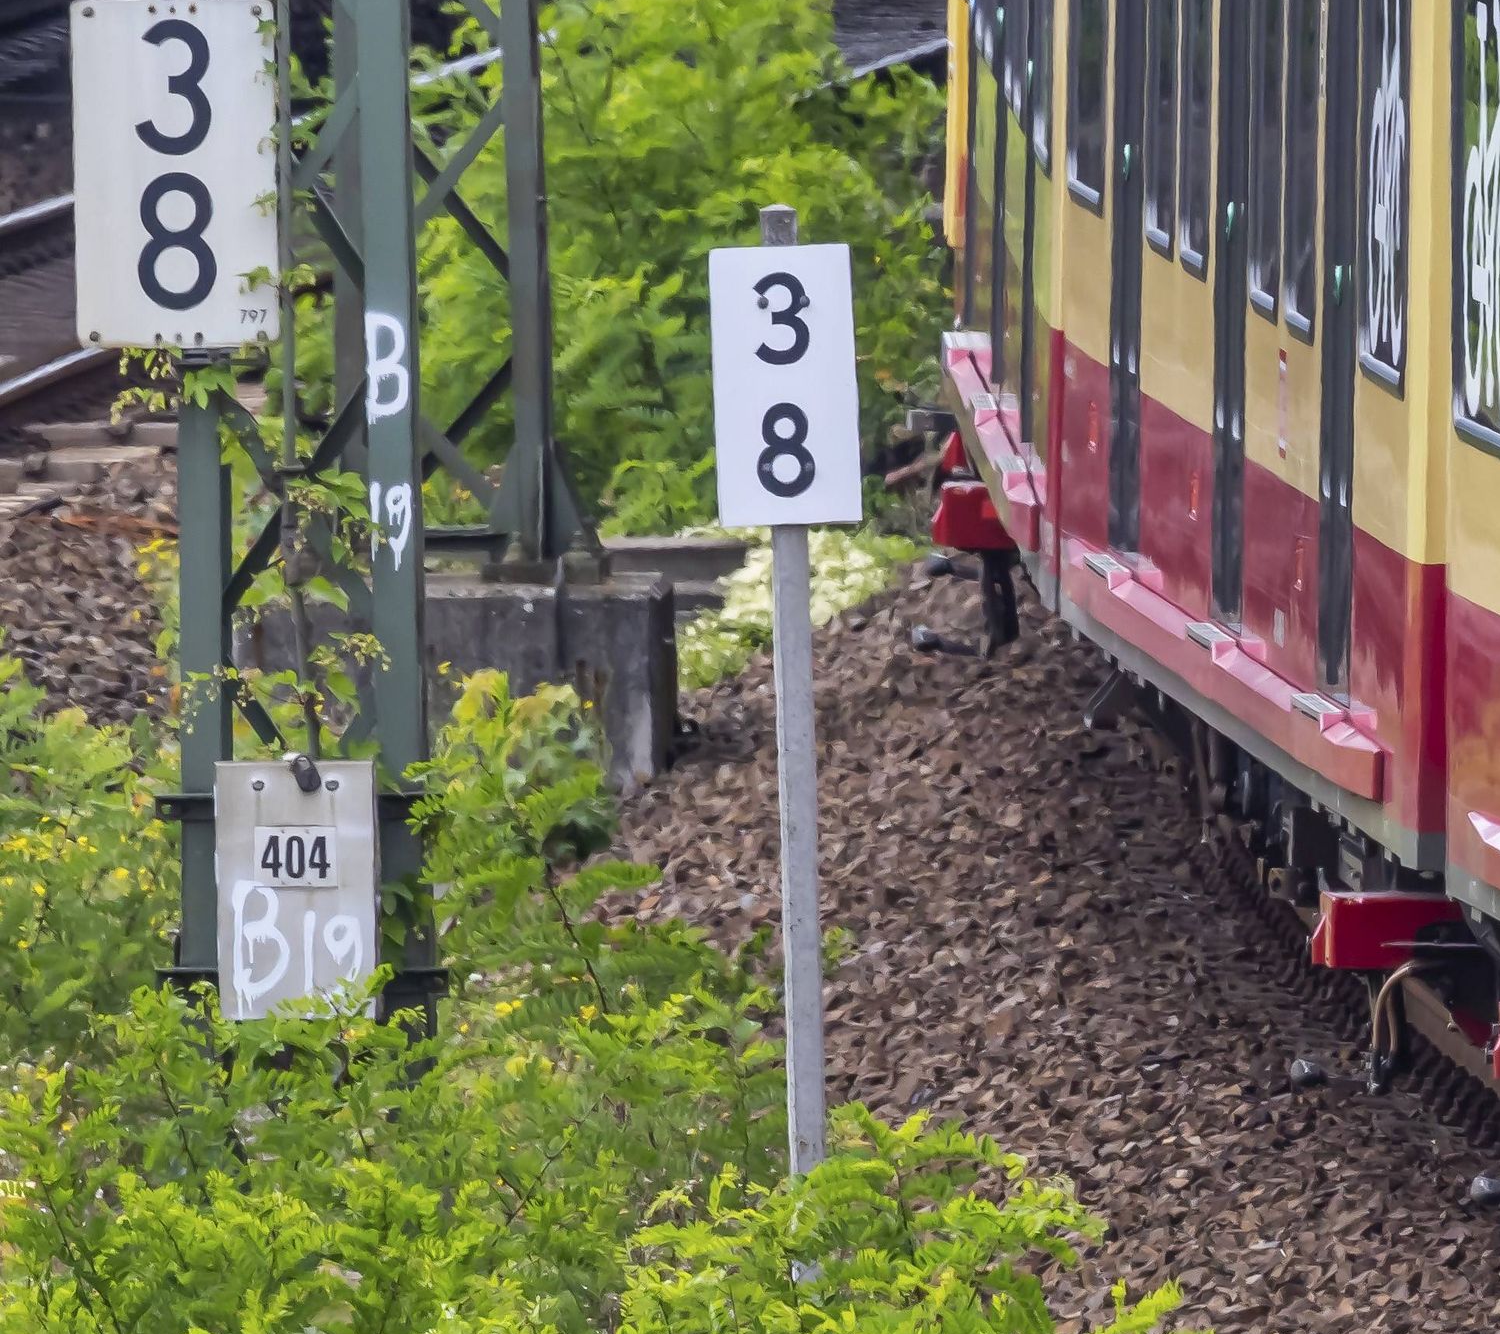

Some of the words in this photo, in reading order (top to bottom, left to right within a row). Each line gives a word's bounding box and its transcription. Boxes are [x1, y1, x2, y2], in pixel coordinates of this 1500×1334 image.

[134, 18, 212, 156] 3
[137, 171, 218, 311] 8
[240, 308, 268, 325] 797
[752, 271, 811, 366] 3
[364, 310, 410, 422] B
[756, 401, 816, 498] 8
[260, 835, 331, 879] 404
